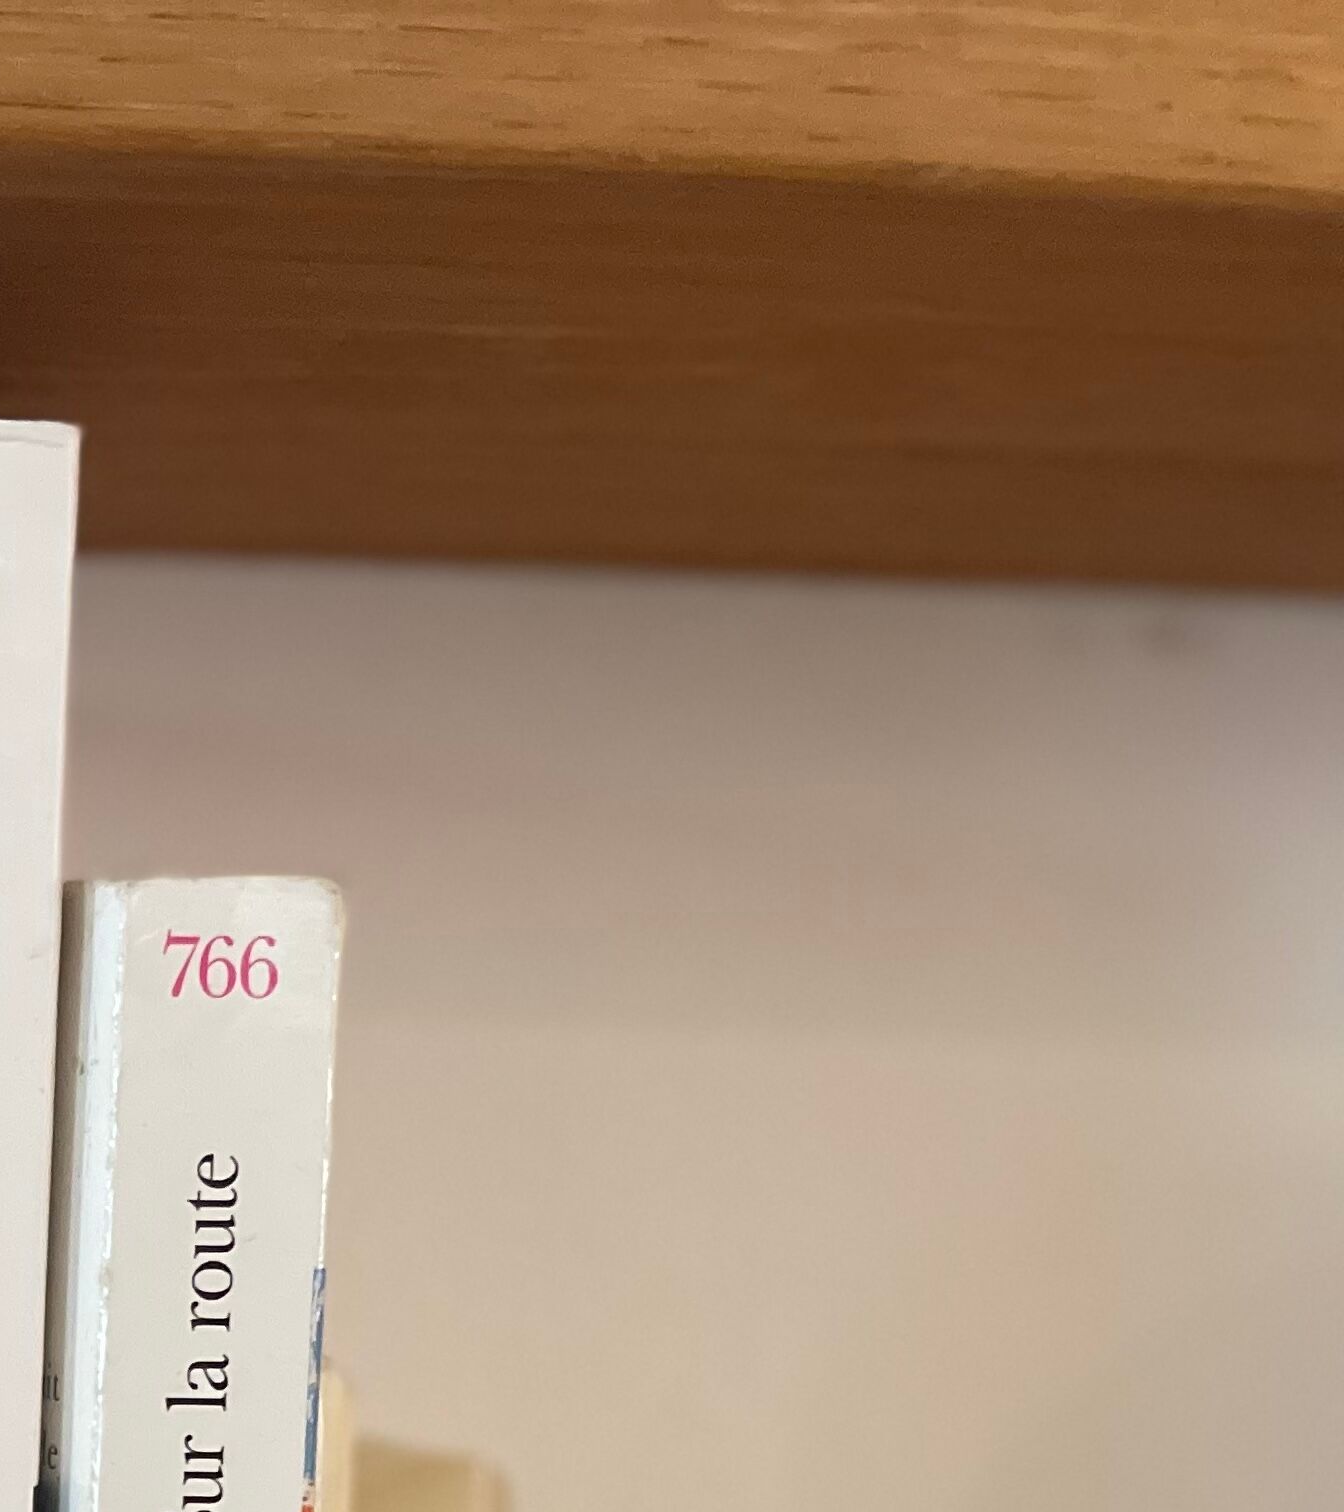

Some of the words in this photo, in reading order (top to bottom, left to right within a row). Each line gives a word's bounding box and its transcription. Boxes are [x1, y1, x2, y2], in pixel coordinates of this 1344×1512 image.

[161, 928, 280, 1001] 766
[185, 1152, 241, 1333] route
[163, 1352, 231, 1413] la
